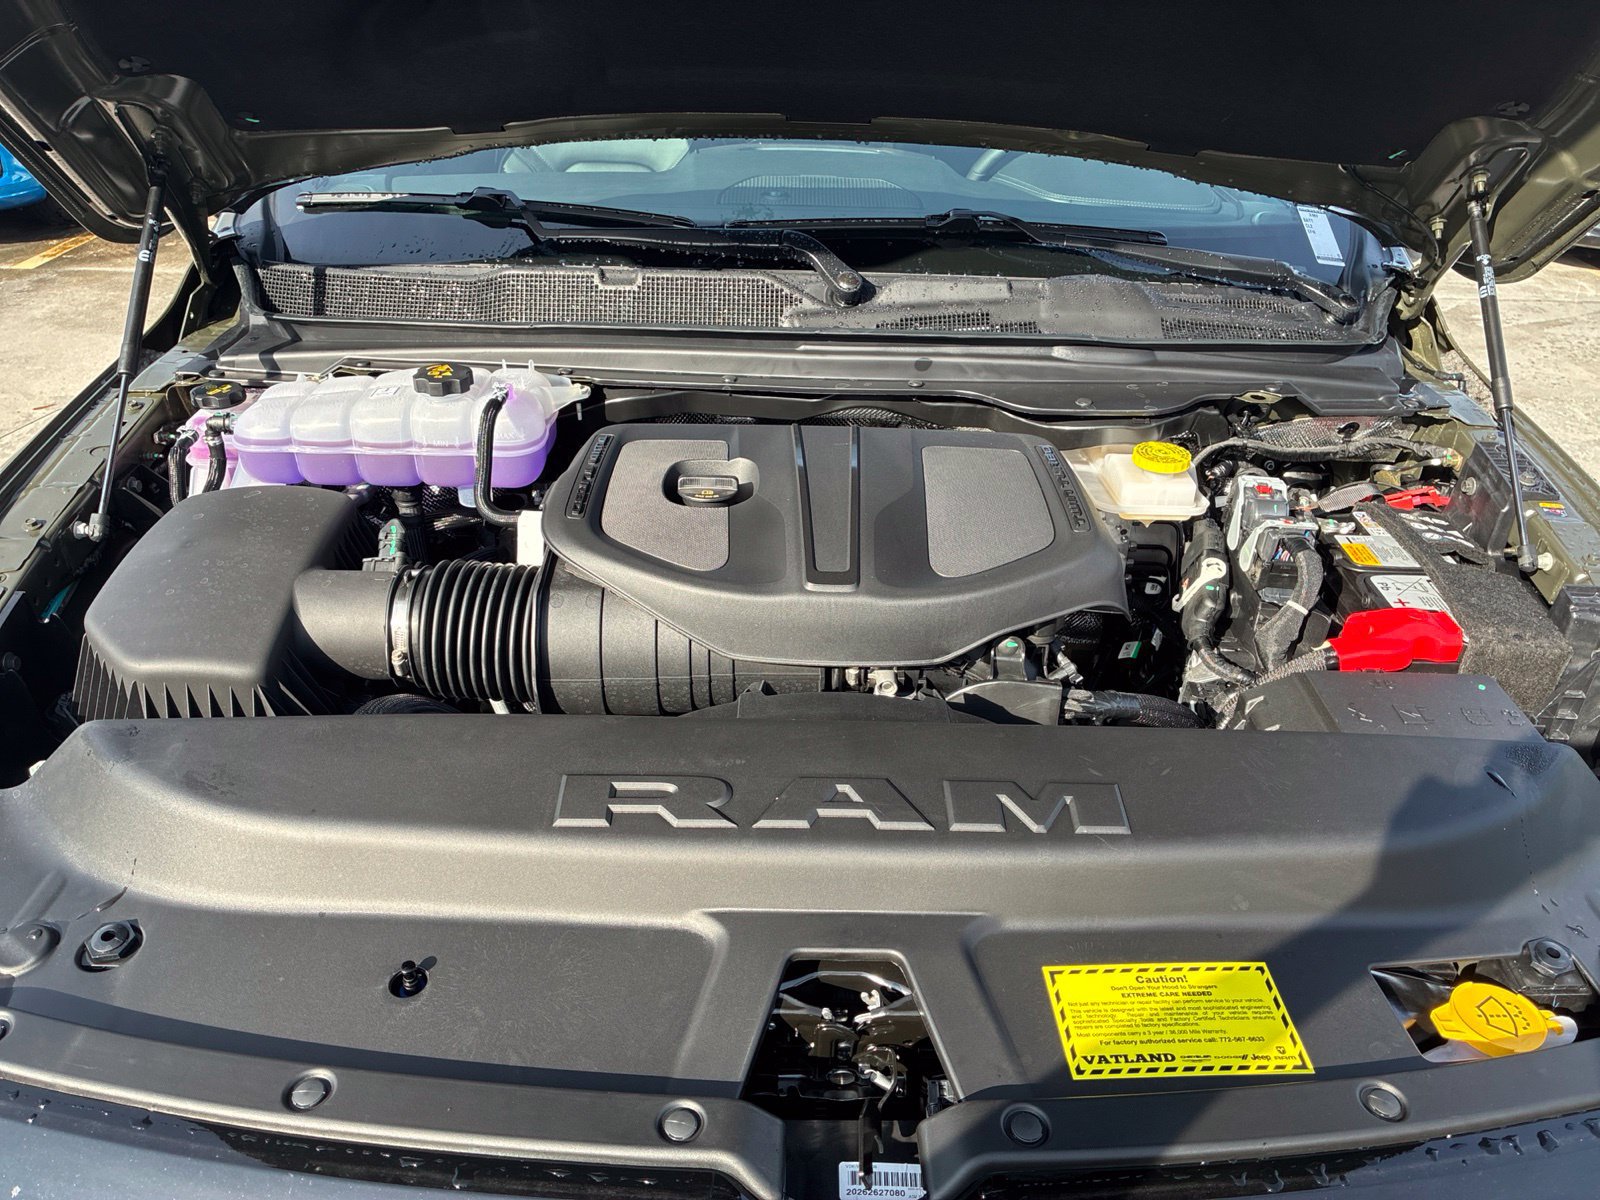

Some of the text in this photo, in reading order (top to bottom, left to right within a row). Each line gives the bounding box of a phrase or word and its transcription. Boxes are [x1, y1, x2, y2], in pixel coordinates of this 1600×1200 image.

[1377, 582, 1392, 591] Pb
[552, 774, 1132, 835] RAM
[1135, 975, 1188, 983] Caution!
[1081, 1053, 1176, 1064] VATLAND
[846, 1188, 906, 1197] 20262627080
